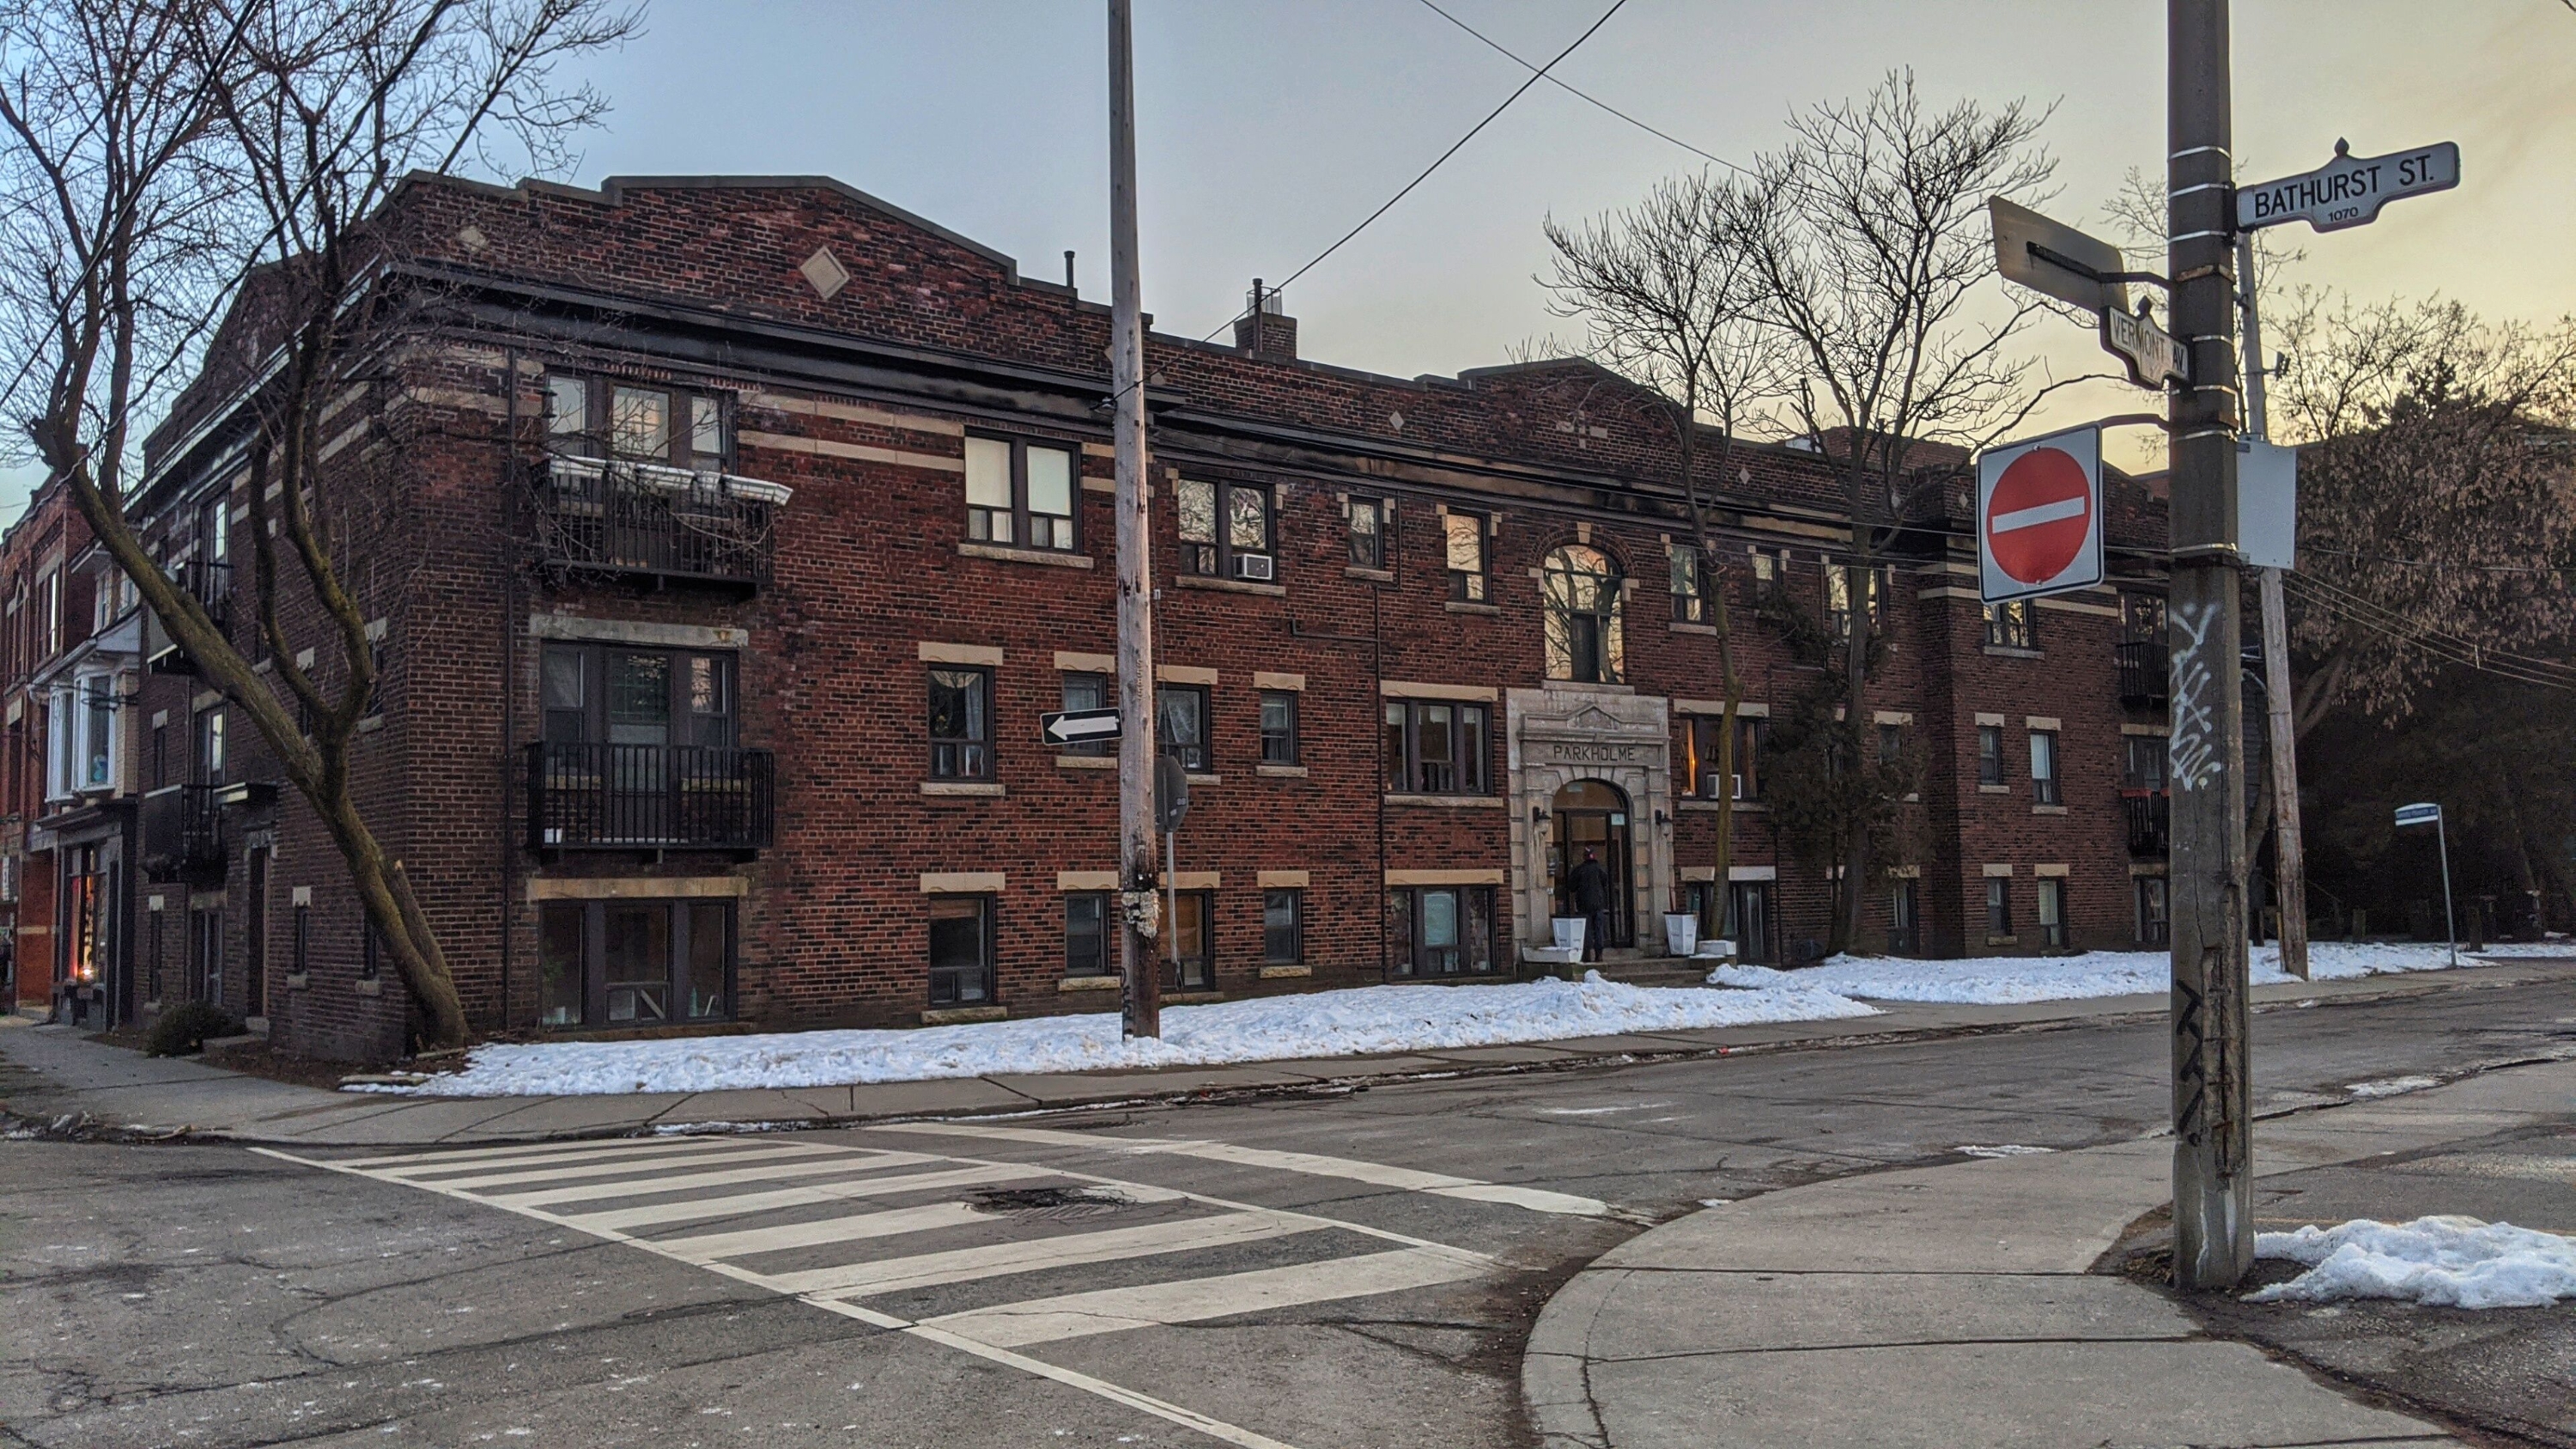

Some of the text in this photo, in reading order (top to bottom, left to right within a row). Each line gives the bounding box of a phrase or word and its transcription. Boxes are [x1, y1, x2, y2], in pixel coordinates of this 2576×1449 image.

[2255, 154, 2434, 218] BATHURST ST.
[2328, 207, 2359, 222] 1070
[2112, 313, 2184, 374] VERMONT AV.
[1553, 746, 1636, 761] PARKHOLME
